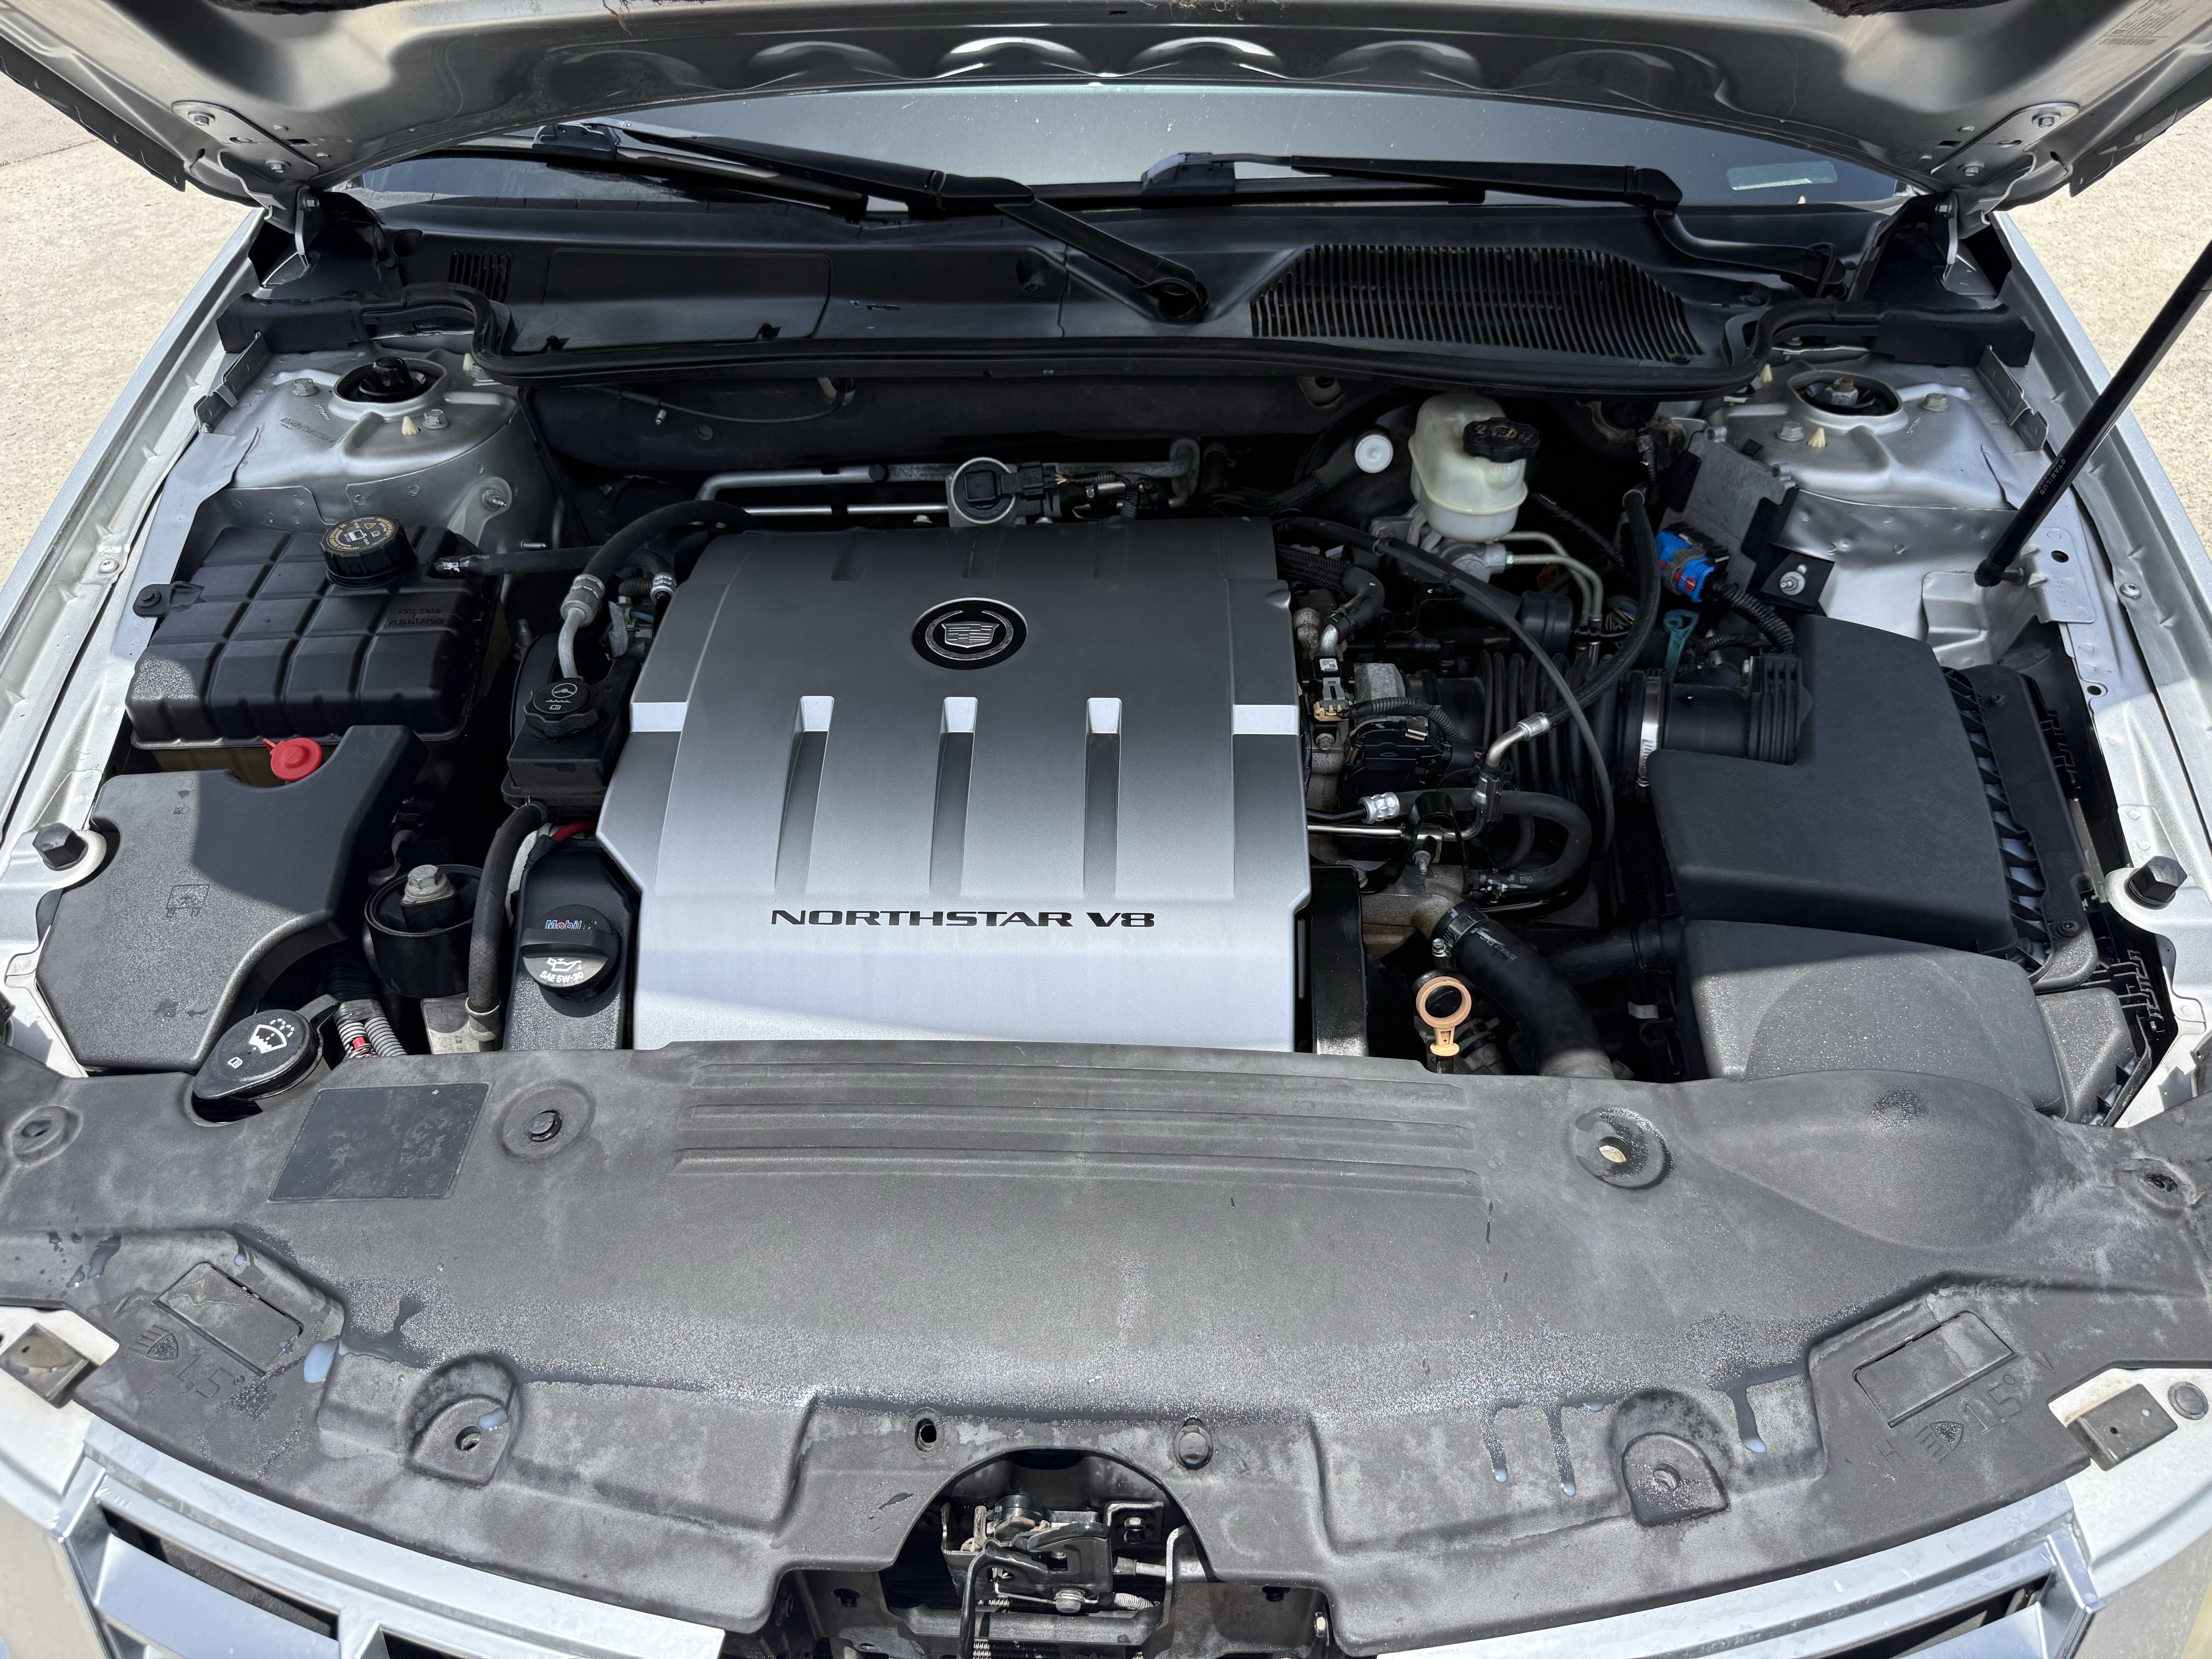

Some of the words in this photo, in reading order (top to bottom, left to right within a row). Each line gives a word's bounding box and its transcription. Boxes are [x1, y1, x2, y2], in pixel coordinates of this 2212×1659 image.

[2040, 457, 2066, 496] STABILUS
[1519, 876, 1534, 884] ENG
[545, 919, 582, 930] Mobil
[772, 910, 1072, 926] NORTHSTAR
[1087, 913, 1154, 927] V8
[539, 970, 556, 982] SAE
[556, 971, 584, 983] 5W-30
